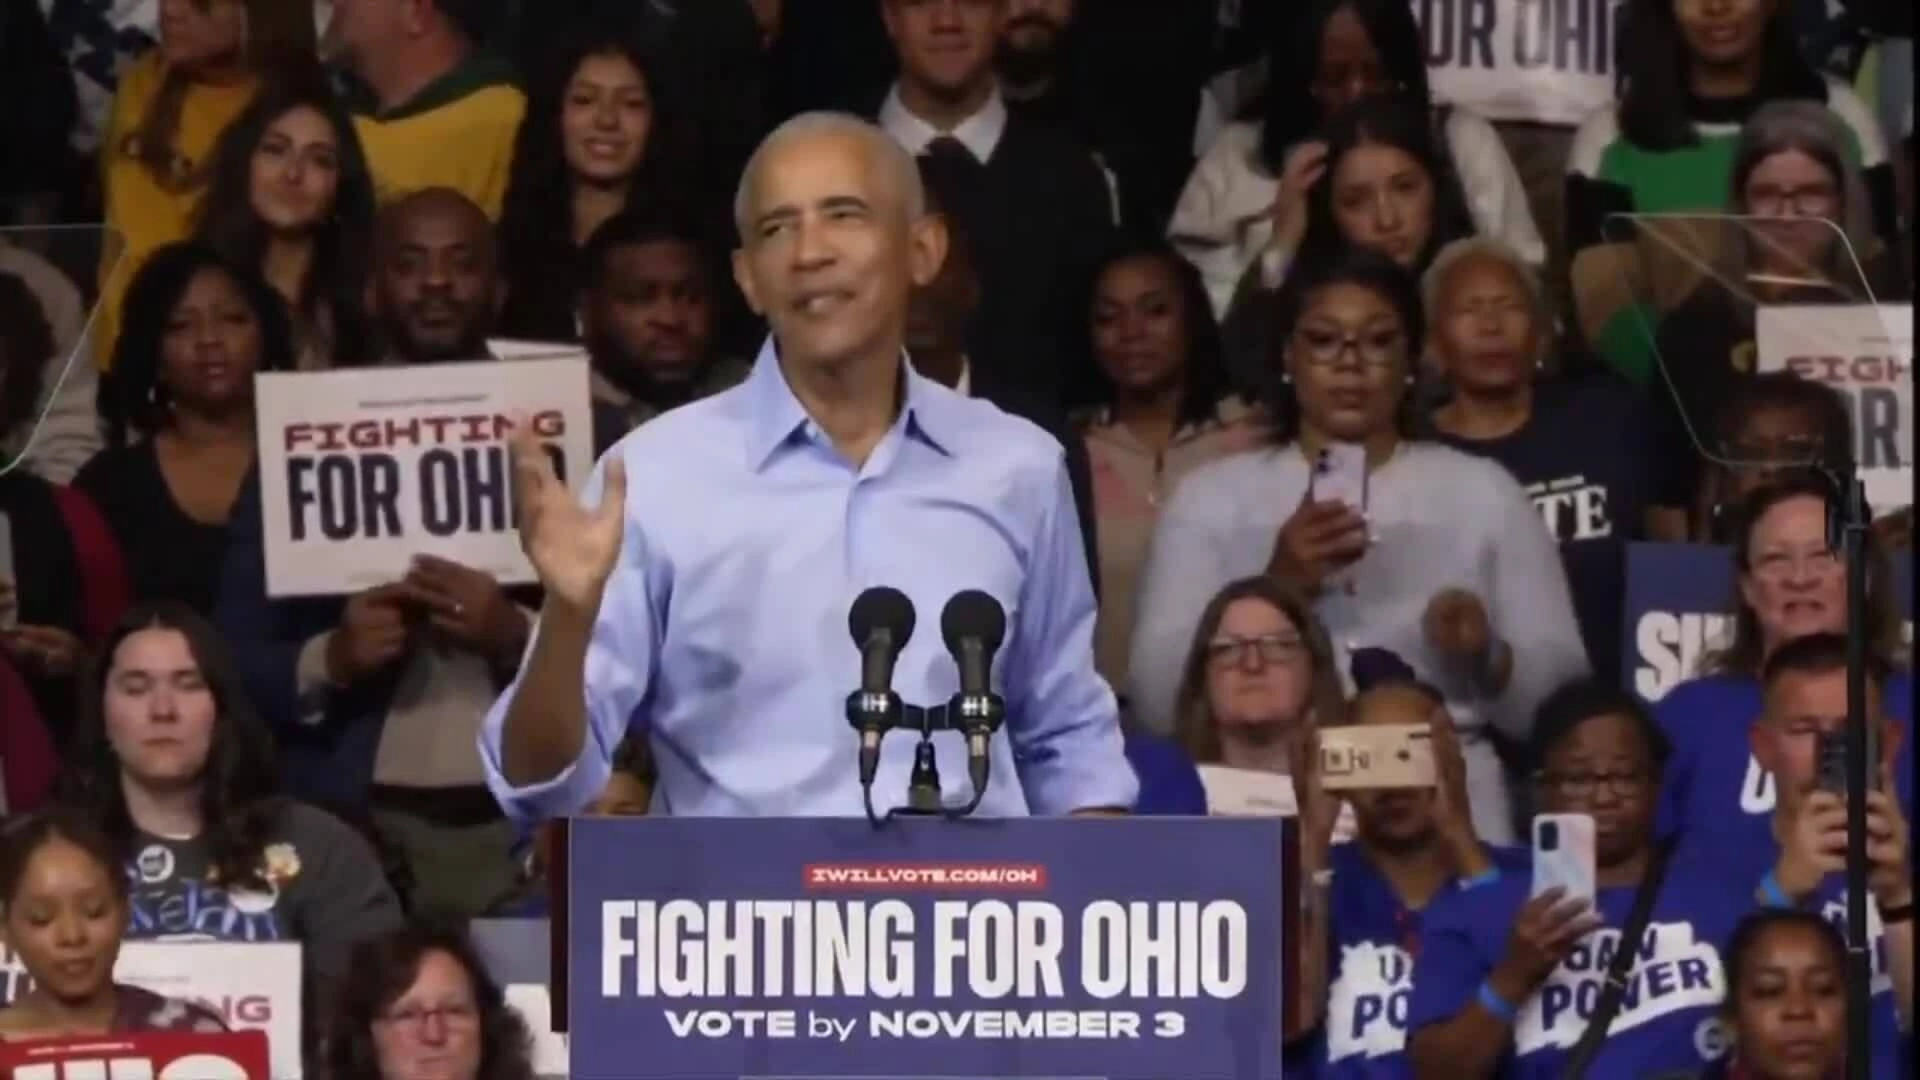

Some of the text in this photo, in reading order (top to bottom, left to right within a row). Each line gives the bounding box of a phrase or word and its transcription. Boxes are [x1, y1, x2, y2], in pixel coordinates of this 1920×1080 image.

[287, 453, 402, 540] FOR
[811, 868, 1038, 883] IWILLVOTE.COM/OH
[602, 899, 1247, 999] FIGHTING FOR OHIO
[664, 1010, 1186, 1042] VOTE by NOVEMBER 3
